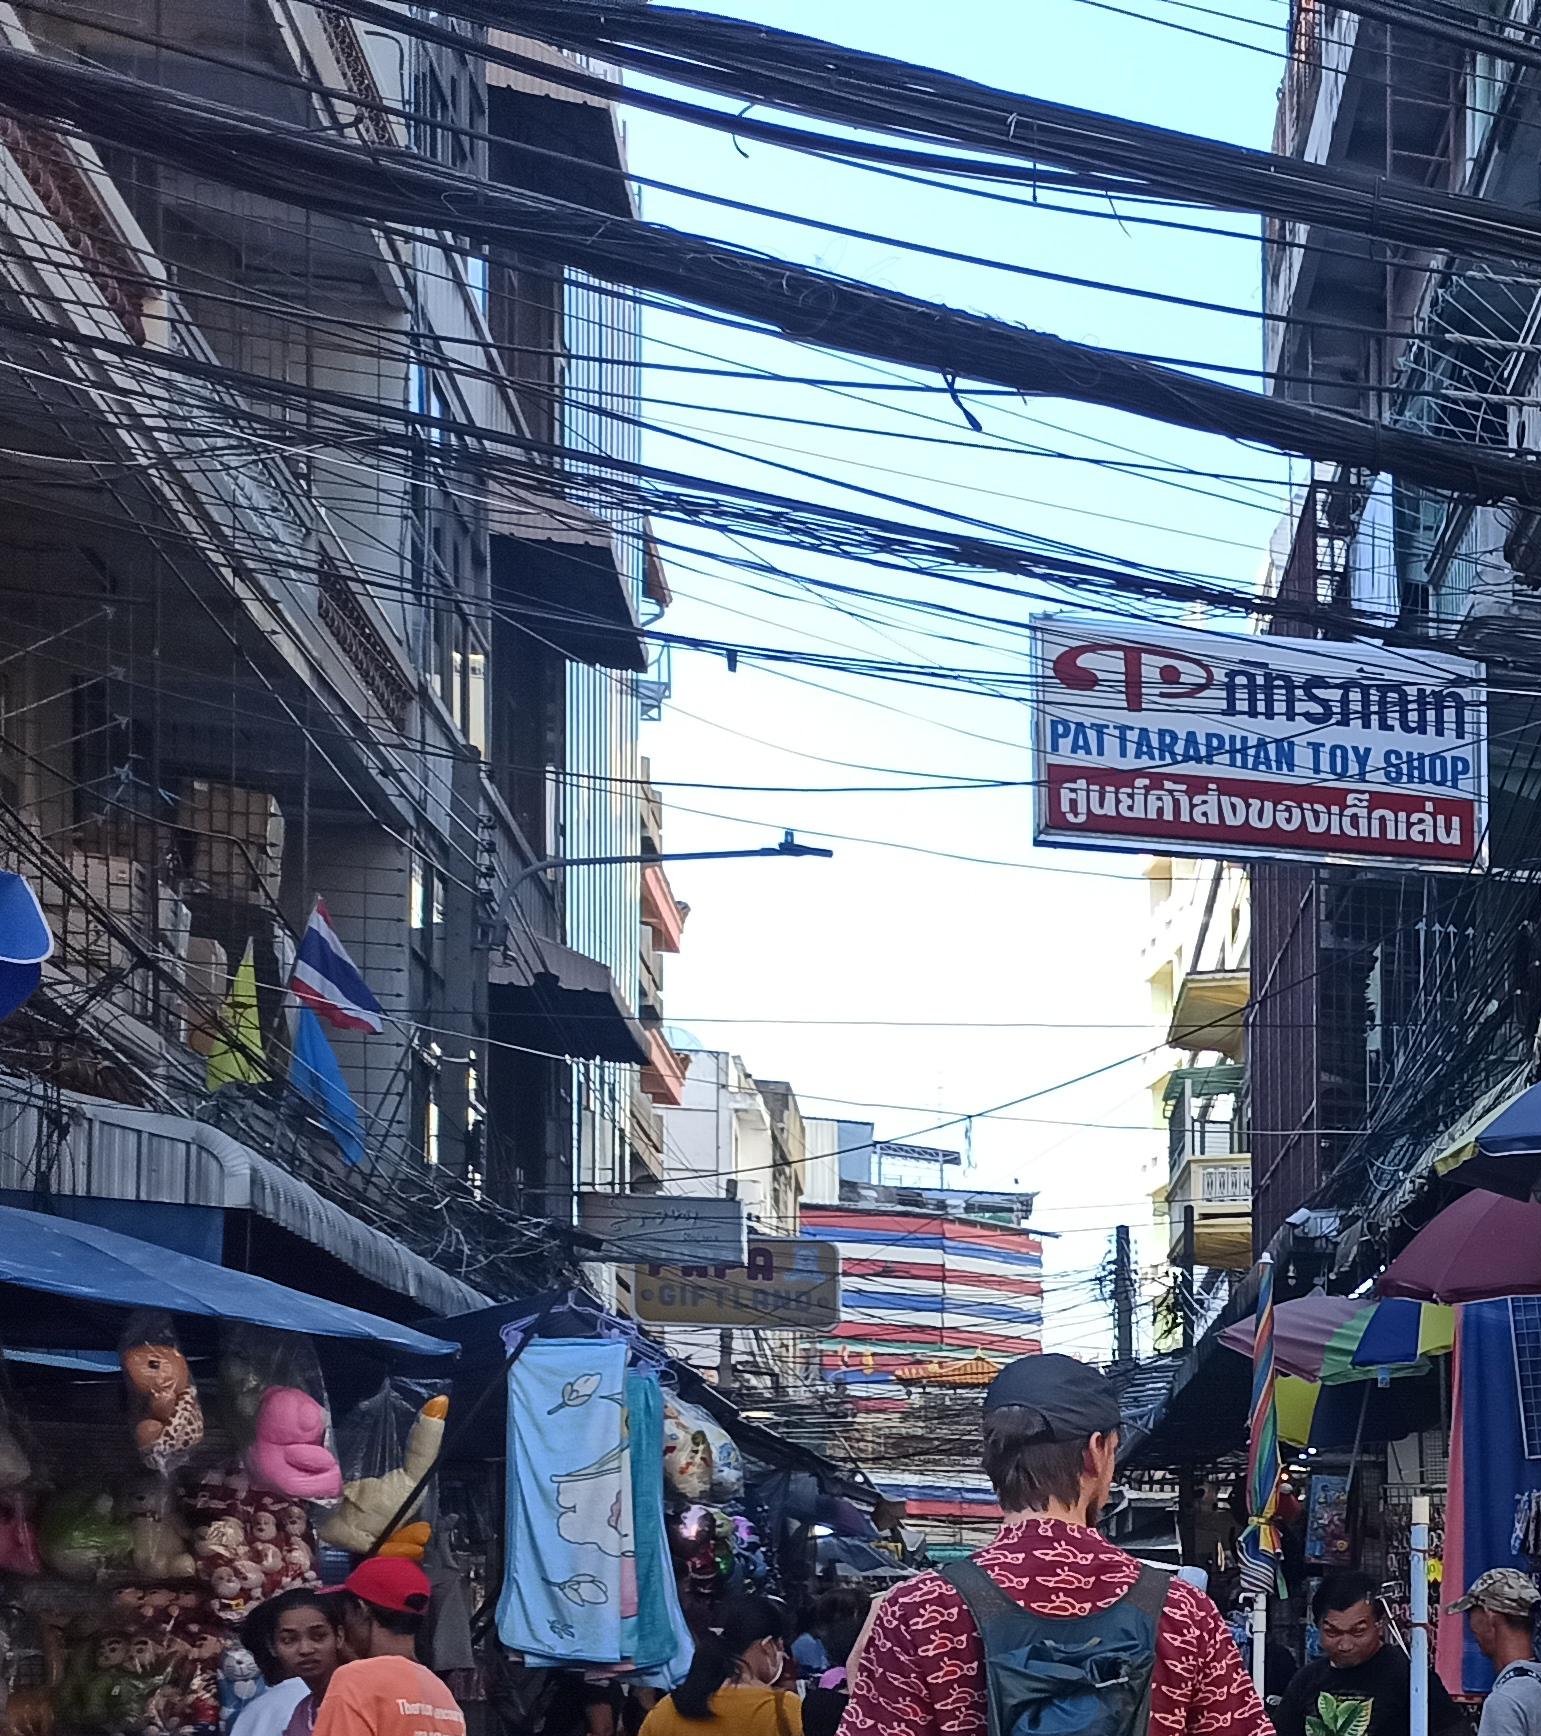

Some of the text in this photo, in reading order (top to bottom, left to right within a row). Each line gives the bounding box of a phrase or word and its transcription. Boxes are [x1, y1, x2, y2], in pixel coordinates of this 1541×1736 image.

[1049, 719, 1471, 789] PATTARAPHAN TOY SHOP
[1059, 777, 1462, 846] ศูนย์ค้าส่งของเด็กเล่น
[658, 1283, 813, 1313] GIFTLAND
